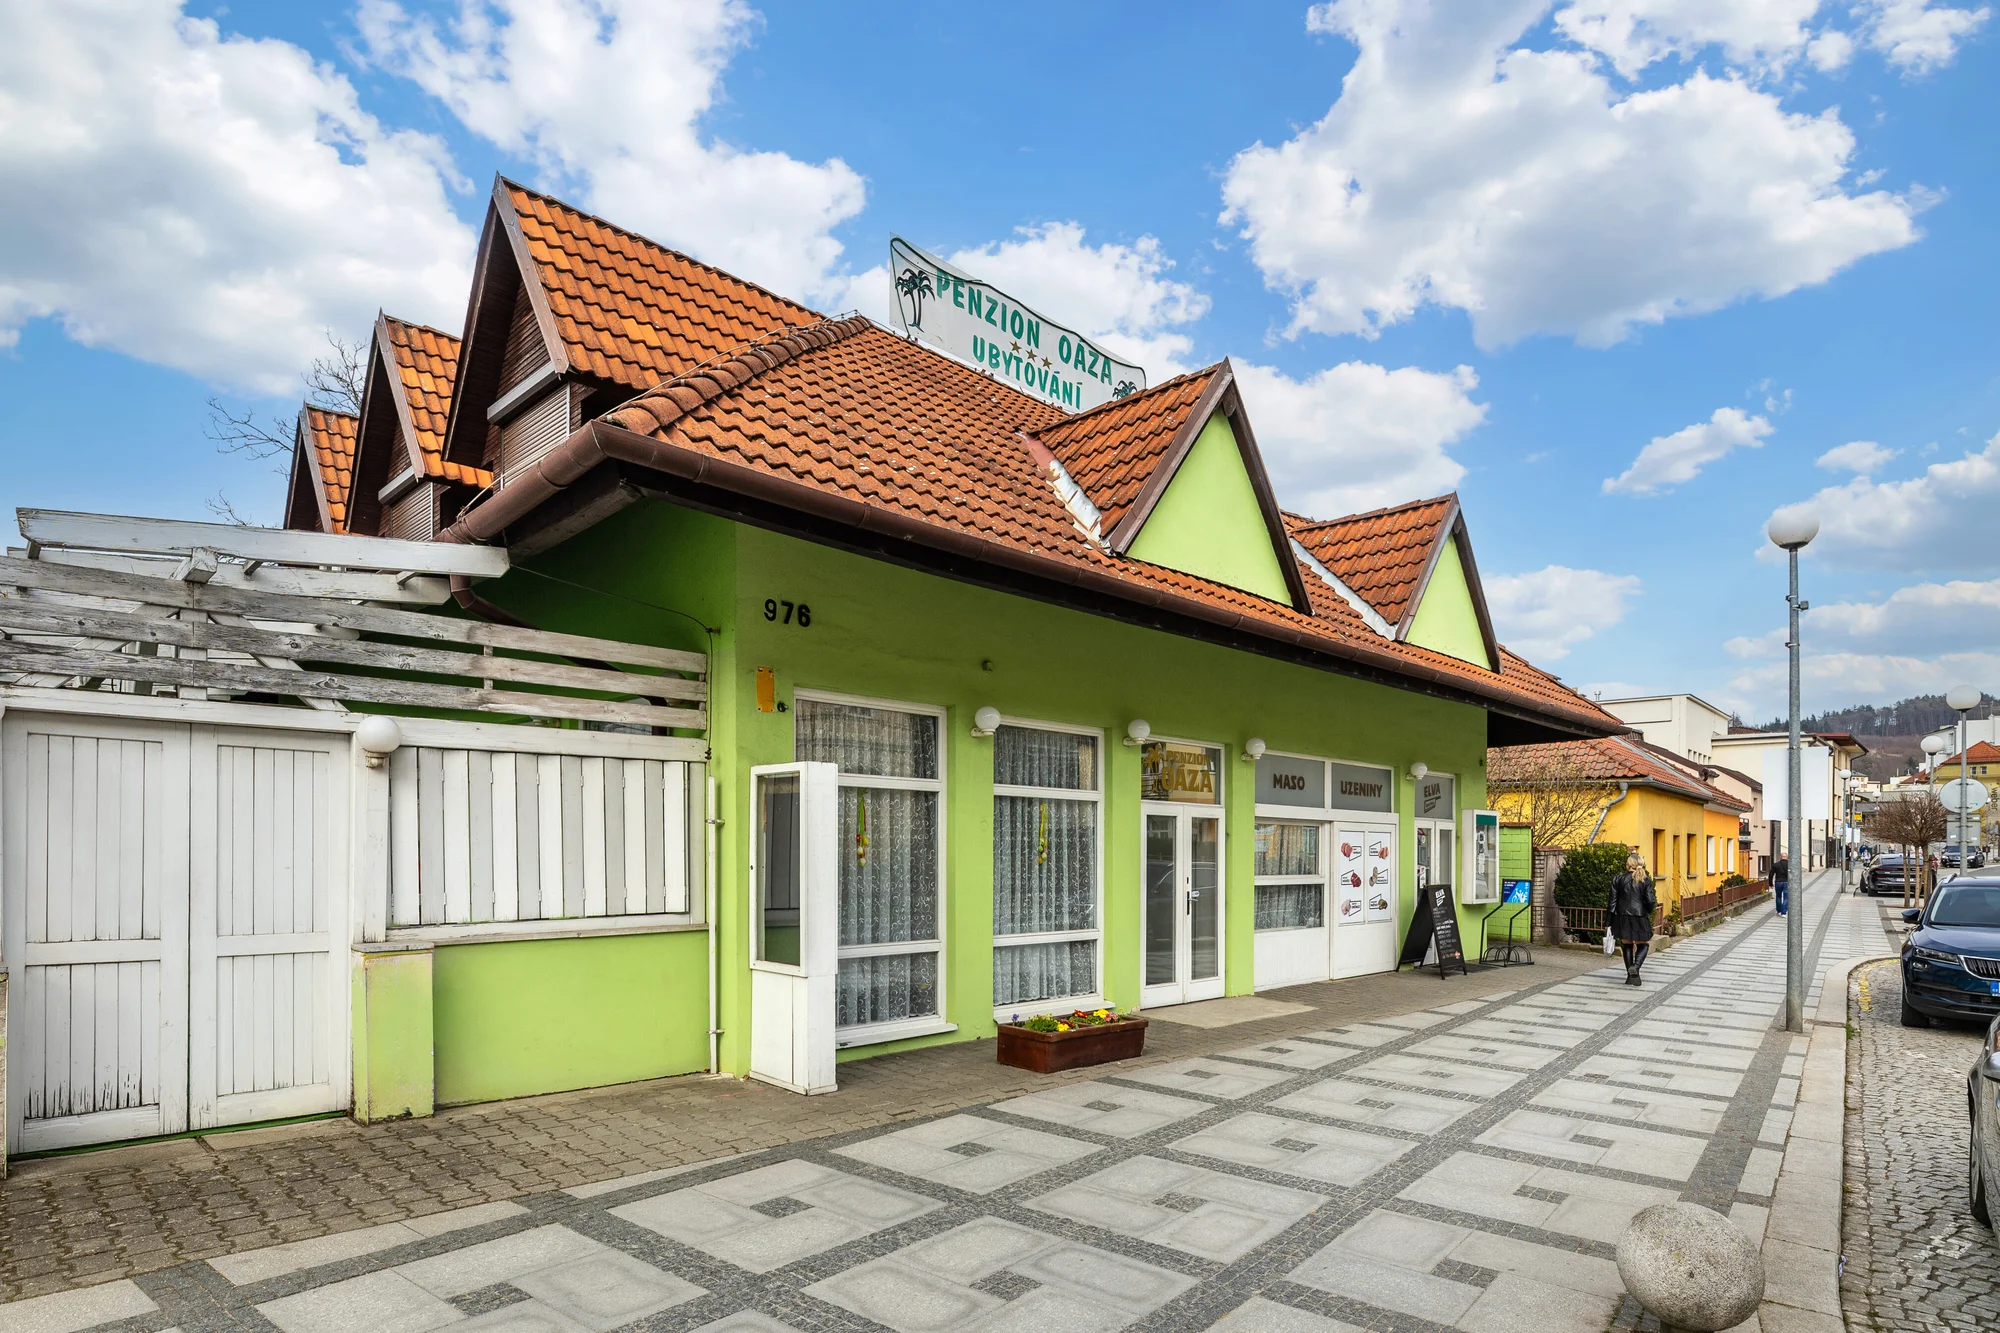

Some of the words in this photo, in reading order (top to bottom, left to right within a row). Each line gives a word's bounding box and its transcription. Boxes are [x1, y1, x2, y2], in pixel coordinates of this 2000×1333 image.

[936, 268, 1040, 349] PENZION
[972, 335, 1084, 410] UBYTOVÁNÍ
[764, 599, 811, 628] 976
[1166, 750, 1211, 771] PENZION
[1161, 763, 1213, 793] OÁZA
[1273, 773, 1305, 791] MASO
[1340, 780, 1383, 798] UZENINY
[1423, 782, 1441, 798] ELVA
[1990, 787, 1999, 811] weber
